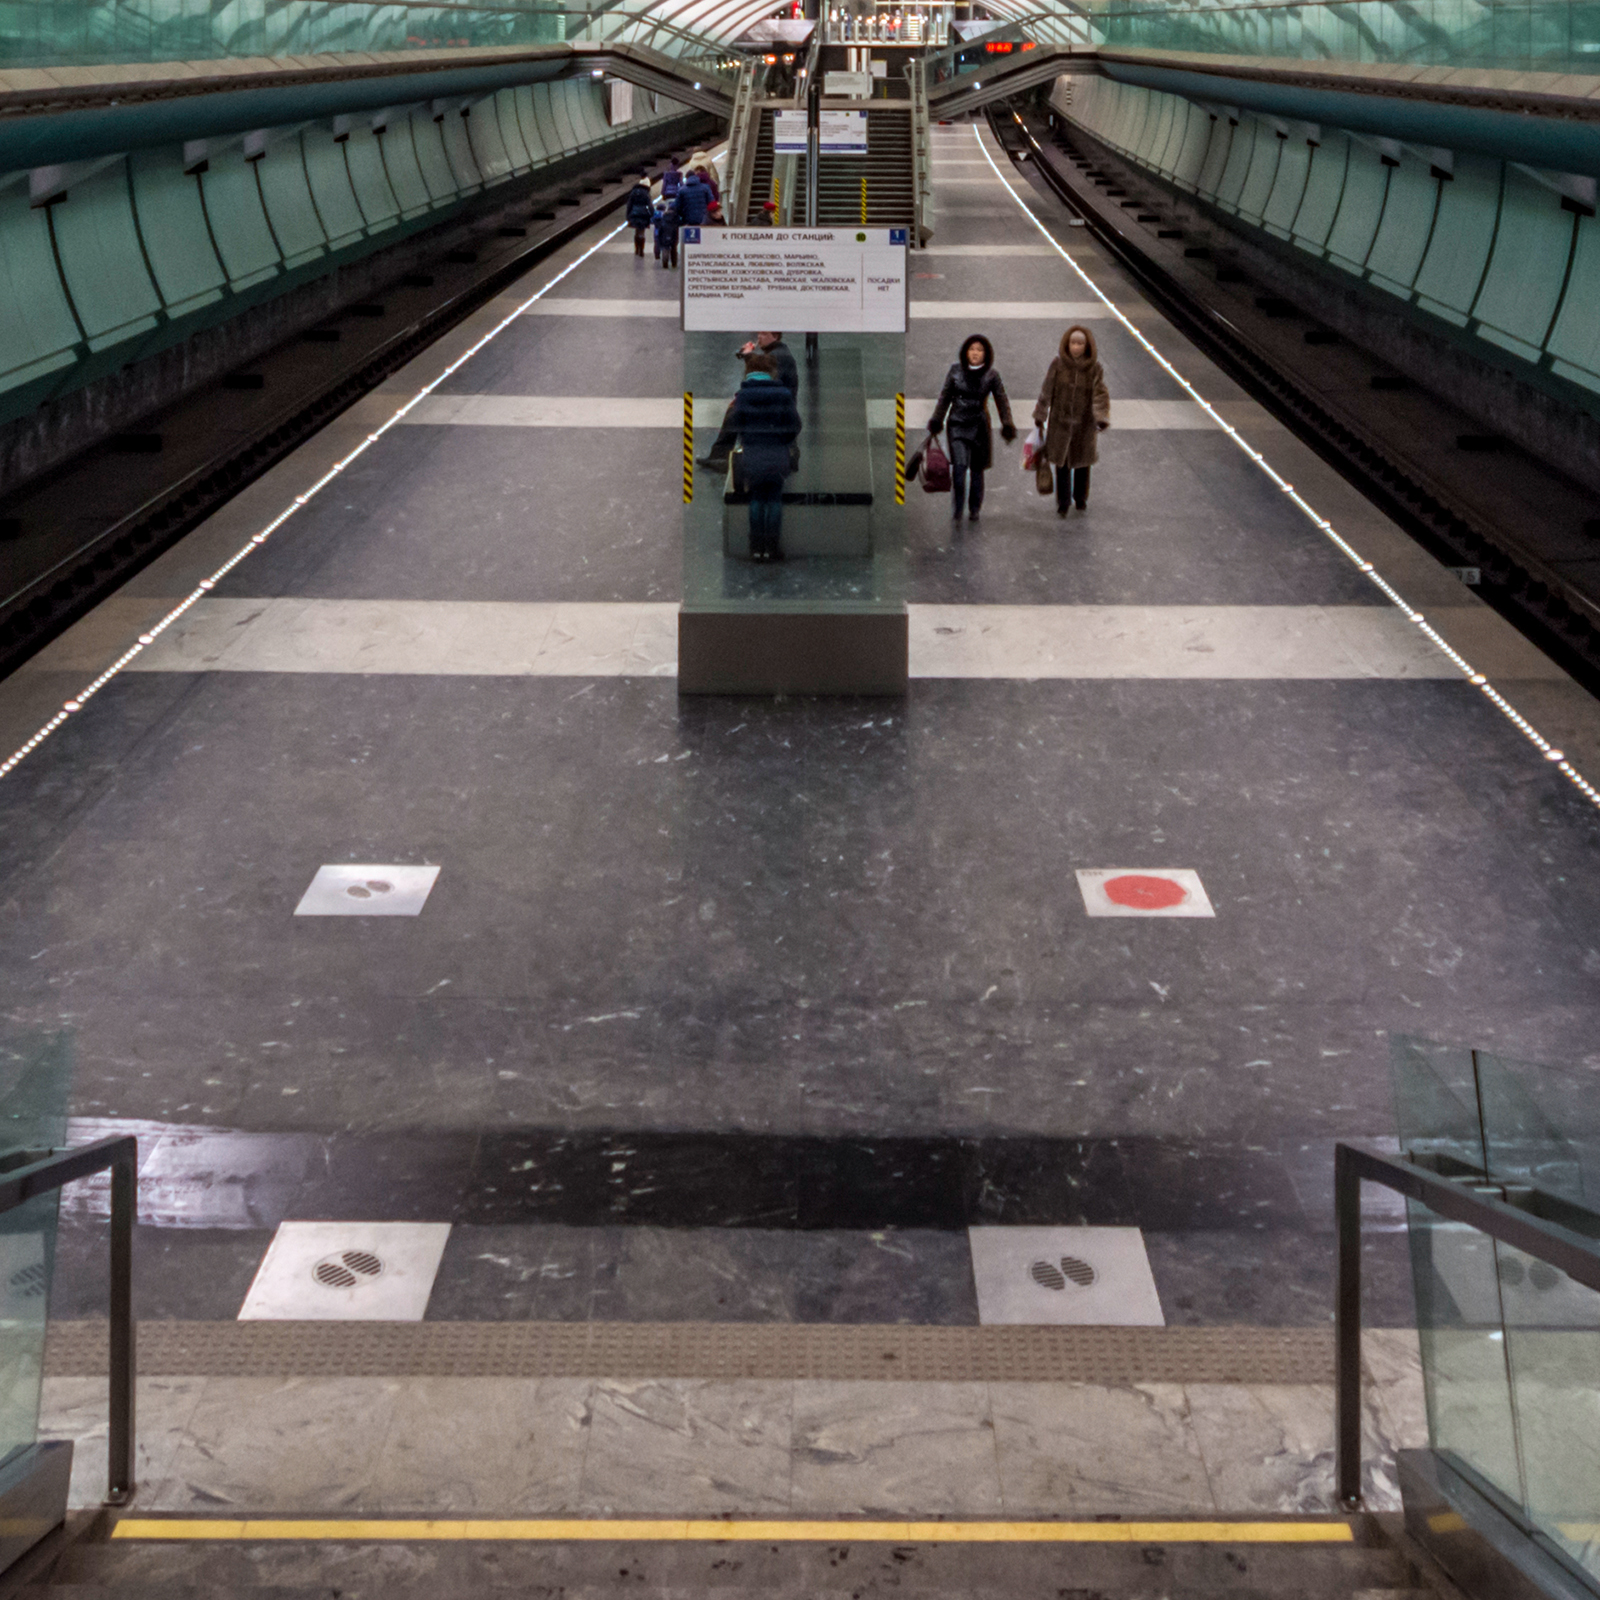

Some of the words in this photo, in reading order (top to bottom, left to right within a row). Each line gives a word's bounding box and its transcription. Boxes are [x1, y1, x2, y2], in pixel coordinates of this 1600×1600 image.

[690, 229, 696, 238] 2
[730, 233, 774, 241] ПОЕЗДАМ
[776, 233, 789, 241] ДО
[792, 232, 836, 241] СТАНЦИЙ:
[894, 230, 899, 239] 1
